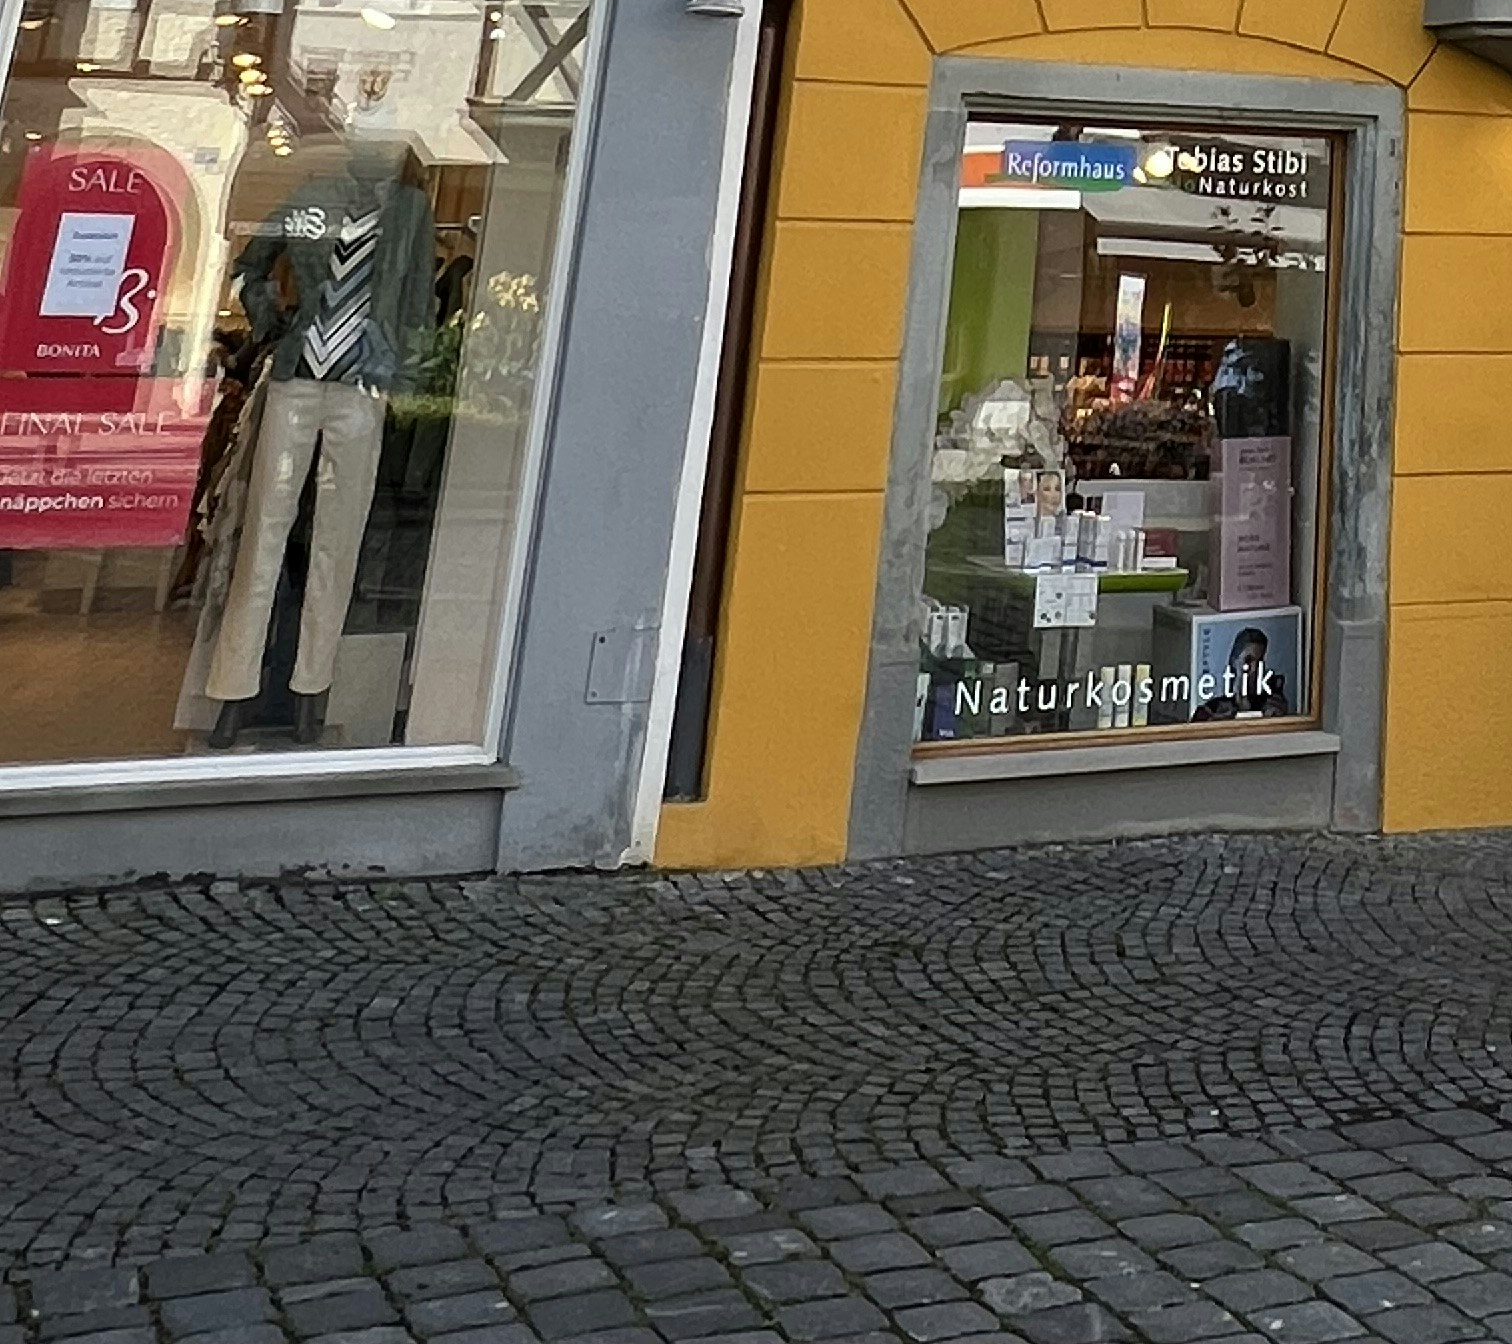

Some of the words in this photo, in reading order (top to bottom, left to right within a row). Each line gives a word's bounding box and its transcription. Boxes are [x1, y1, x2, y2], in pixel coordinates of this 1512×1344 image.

[1007, 151, 1126, 185] Reformhaus
[1165, 145, 1243, 174] Tobias
[1252, 150, 1308, 175] Stibi
[68, 168, 142, 193] SALE
[36, 344, 100, 358] BONITA
[0, 412, 83, 436] FINAL
[99, 412, 174, 436] SALE
[954, 660, 1275, 716] Naturkosmetik
